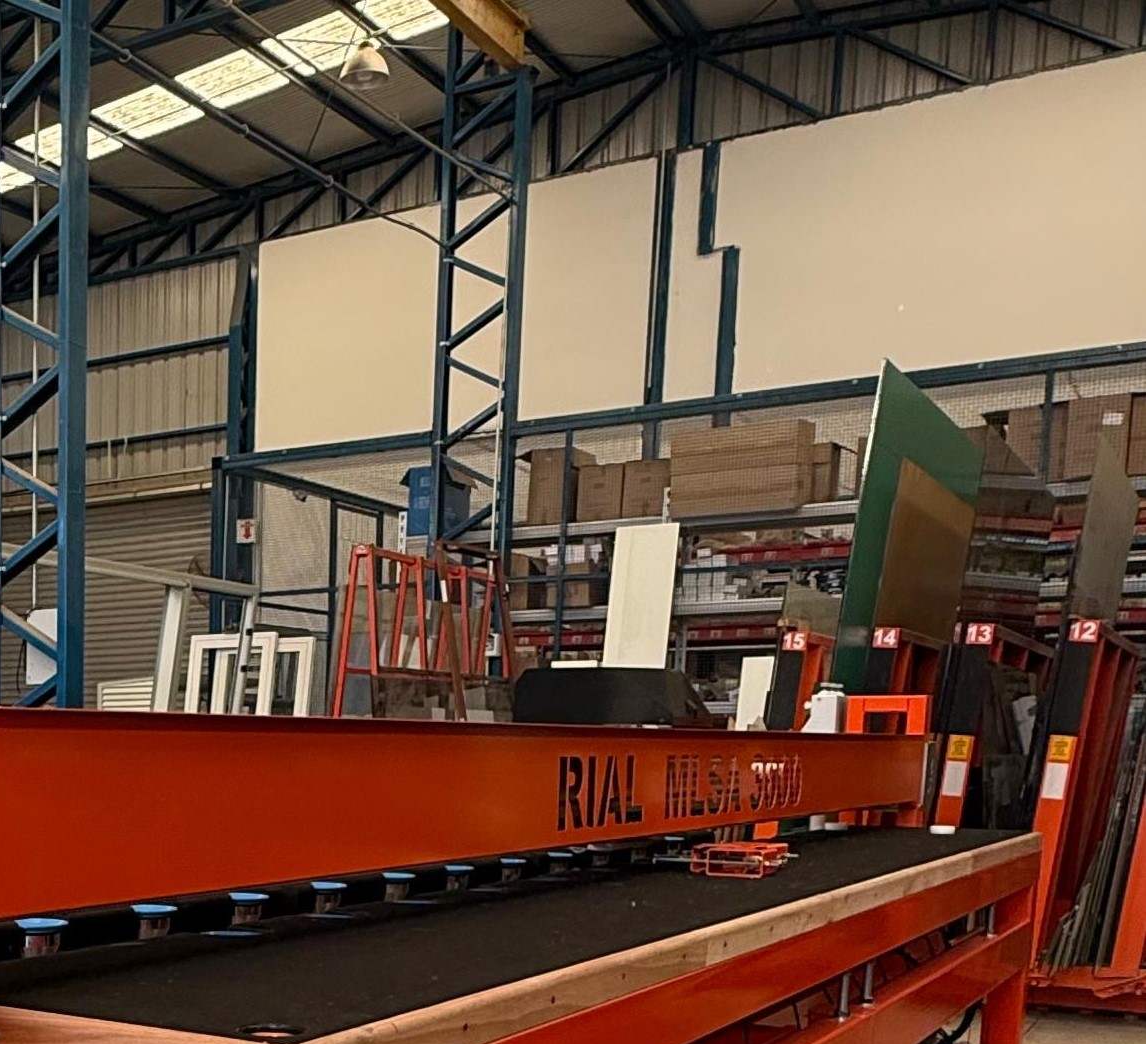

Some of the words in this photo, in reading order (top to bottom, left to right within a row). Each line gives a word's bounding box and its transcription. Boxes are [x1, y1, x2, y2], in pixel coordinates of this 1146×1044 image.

[874, 629, 896, 646] 14
[968, 624, 992, 642] 13
[1069, 620, 1096, 640] 12
[783, 632, 805, 649] 15
[557, 753, 643, 832] RIAL
[664, 754, 742, 820] MLSA
